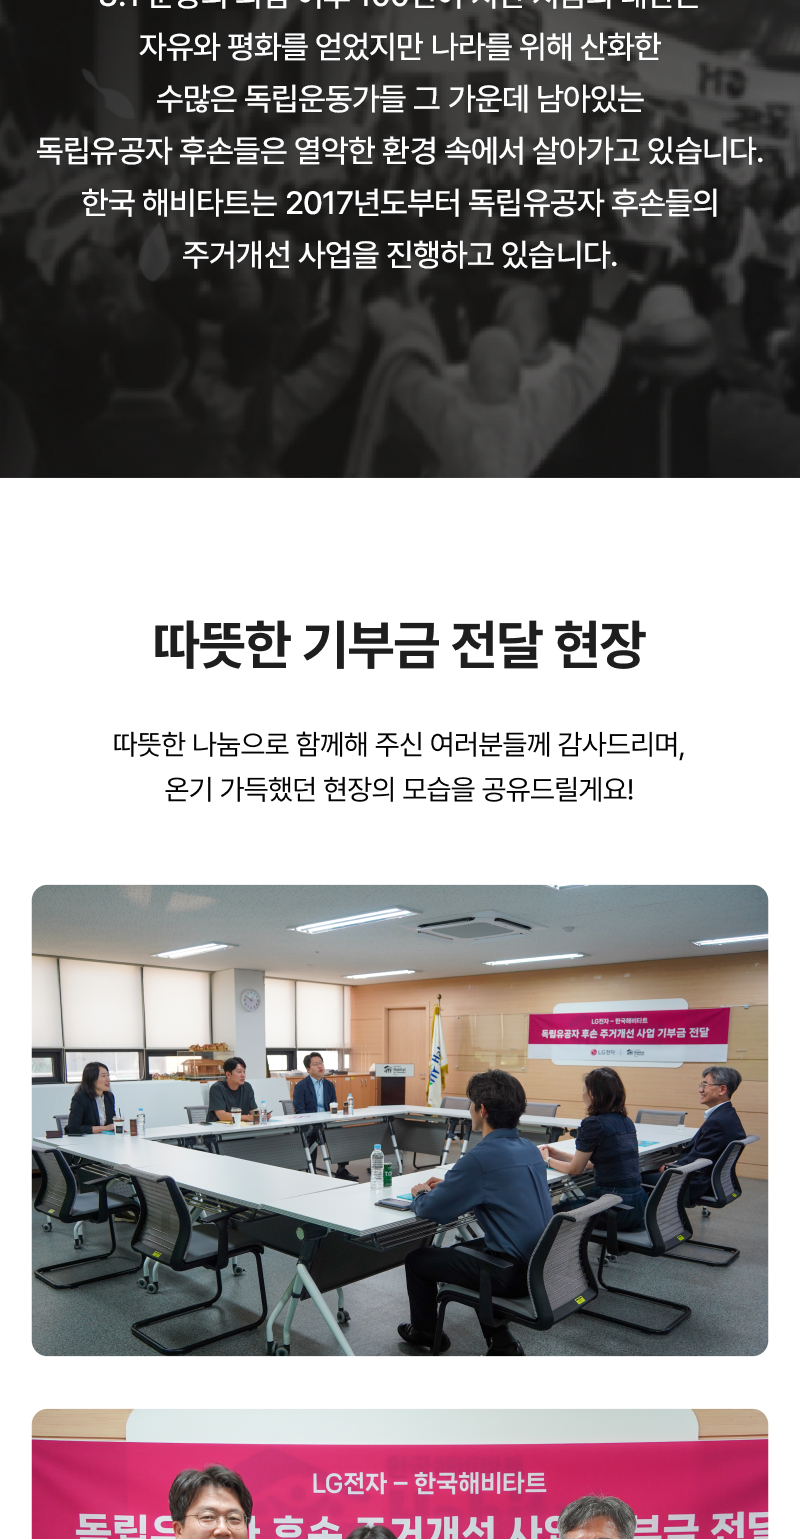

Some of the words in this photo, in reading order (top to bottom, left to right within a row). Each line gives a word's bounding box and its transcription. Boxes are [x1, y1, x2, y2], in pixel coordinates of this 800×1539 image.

[82, 189, 135, 217] 한국
[143, 189, 277, 217] 해비타트는
[287, 189, 458, 217] 2017년도부터
[469, 189, 604, 217] 독립유공자
[612, 188, 716, 217] 후손들의
[155, 620, 291, 669] 따뜻한
[304, 620, 439, 669] 기부금
[452, 620, 543, 669] 전달
[555, 620, 646, 669] 현장
[541, 1028, 579, 1039] 독립유공자
[581, 1028, 598, 1039] 후손
[600, 1028, 635, 1039] 주거개선
[636, 1028, 655, 1039] 사업
[657, 1027, 687, 1039] 기부금
[689, 1026, 709, 1038] 전달
[312, 1471, 387, 1495] LG전자
[414, 1471, 547, 1496] 한국해비타트
